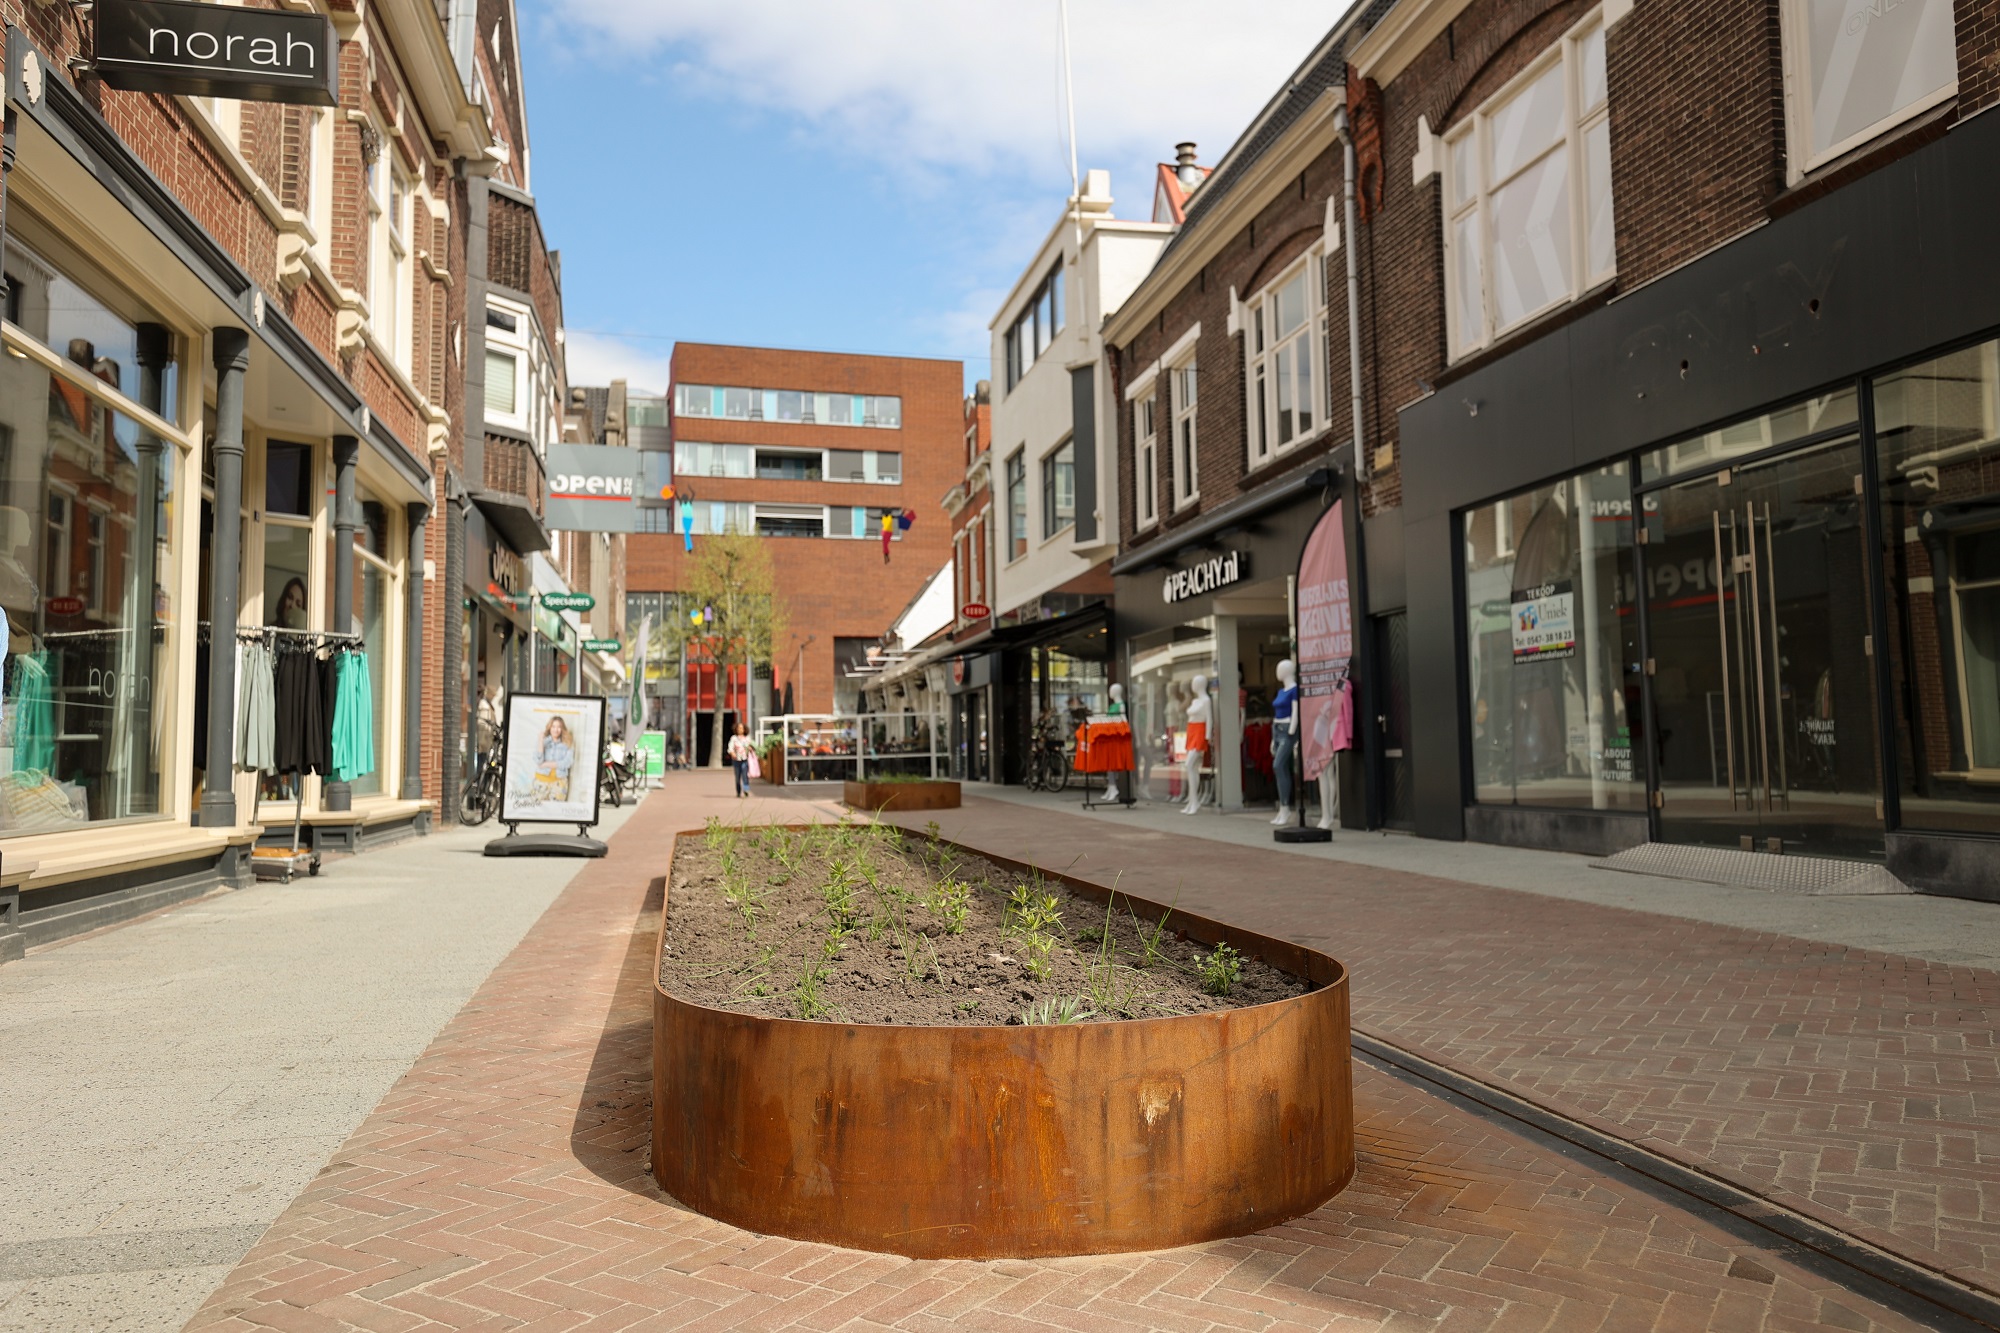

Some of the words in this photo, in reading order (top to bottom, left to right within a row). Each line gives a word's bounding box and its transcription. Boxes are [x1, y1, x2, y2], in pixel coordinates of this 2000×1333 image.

[150, 28, 315, 69] norah
[1172, 550, 1239, 602] PEACHY.nl
[1526, 589, 1535, 600] TE
[1536, 584, 1556, 599] KOOP
[544, 595, 590, 608] Specsavers
[1538, 597, 1568, 621] Uniek
[1604, 749, 1632, 759] ABOUT
[1615, 760, 1632, 770] THE
[1601, 770, 1633, 781] FUTURE
